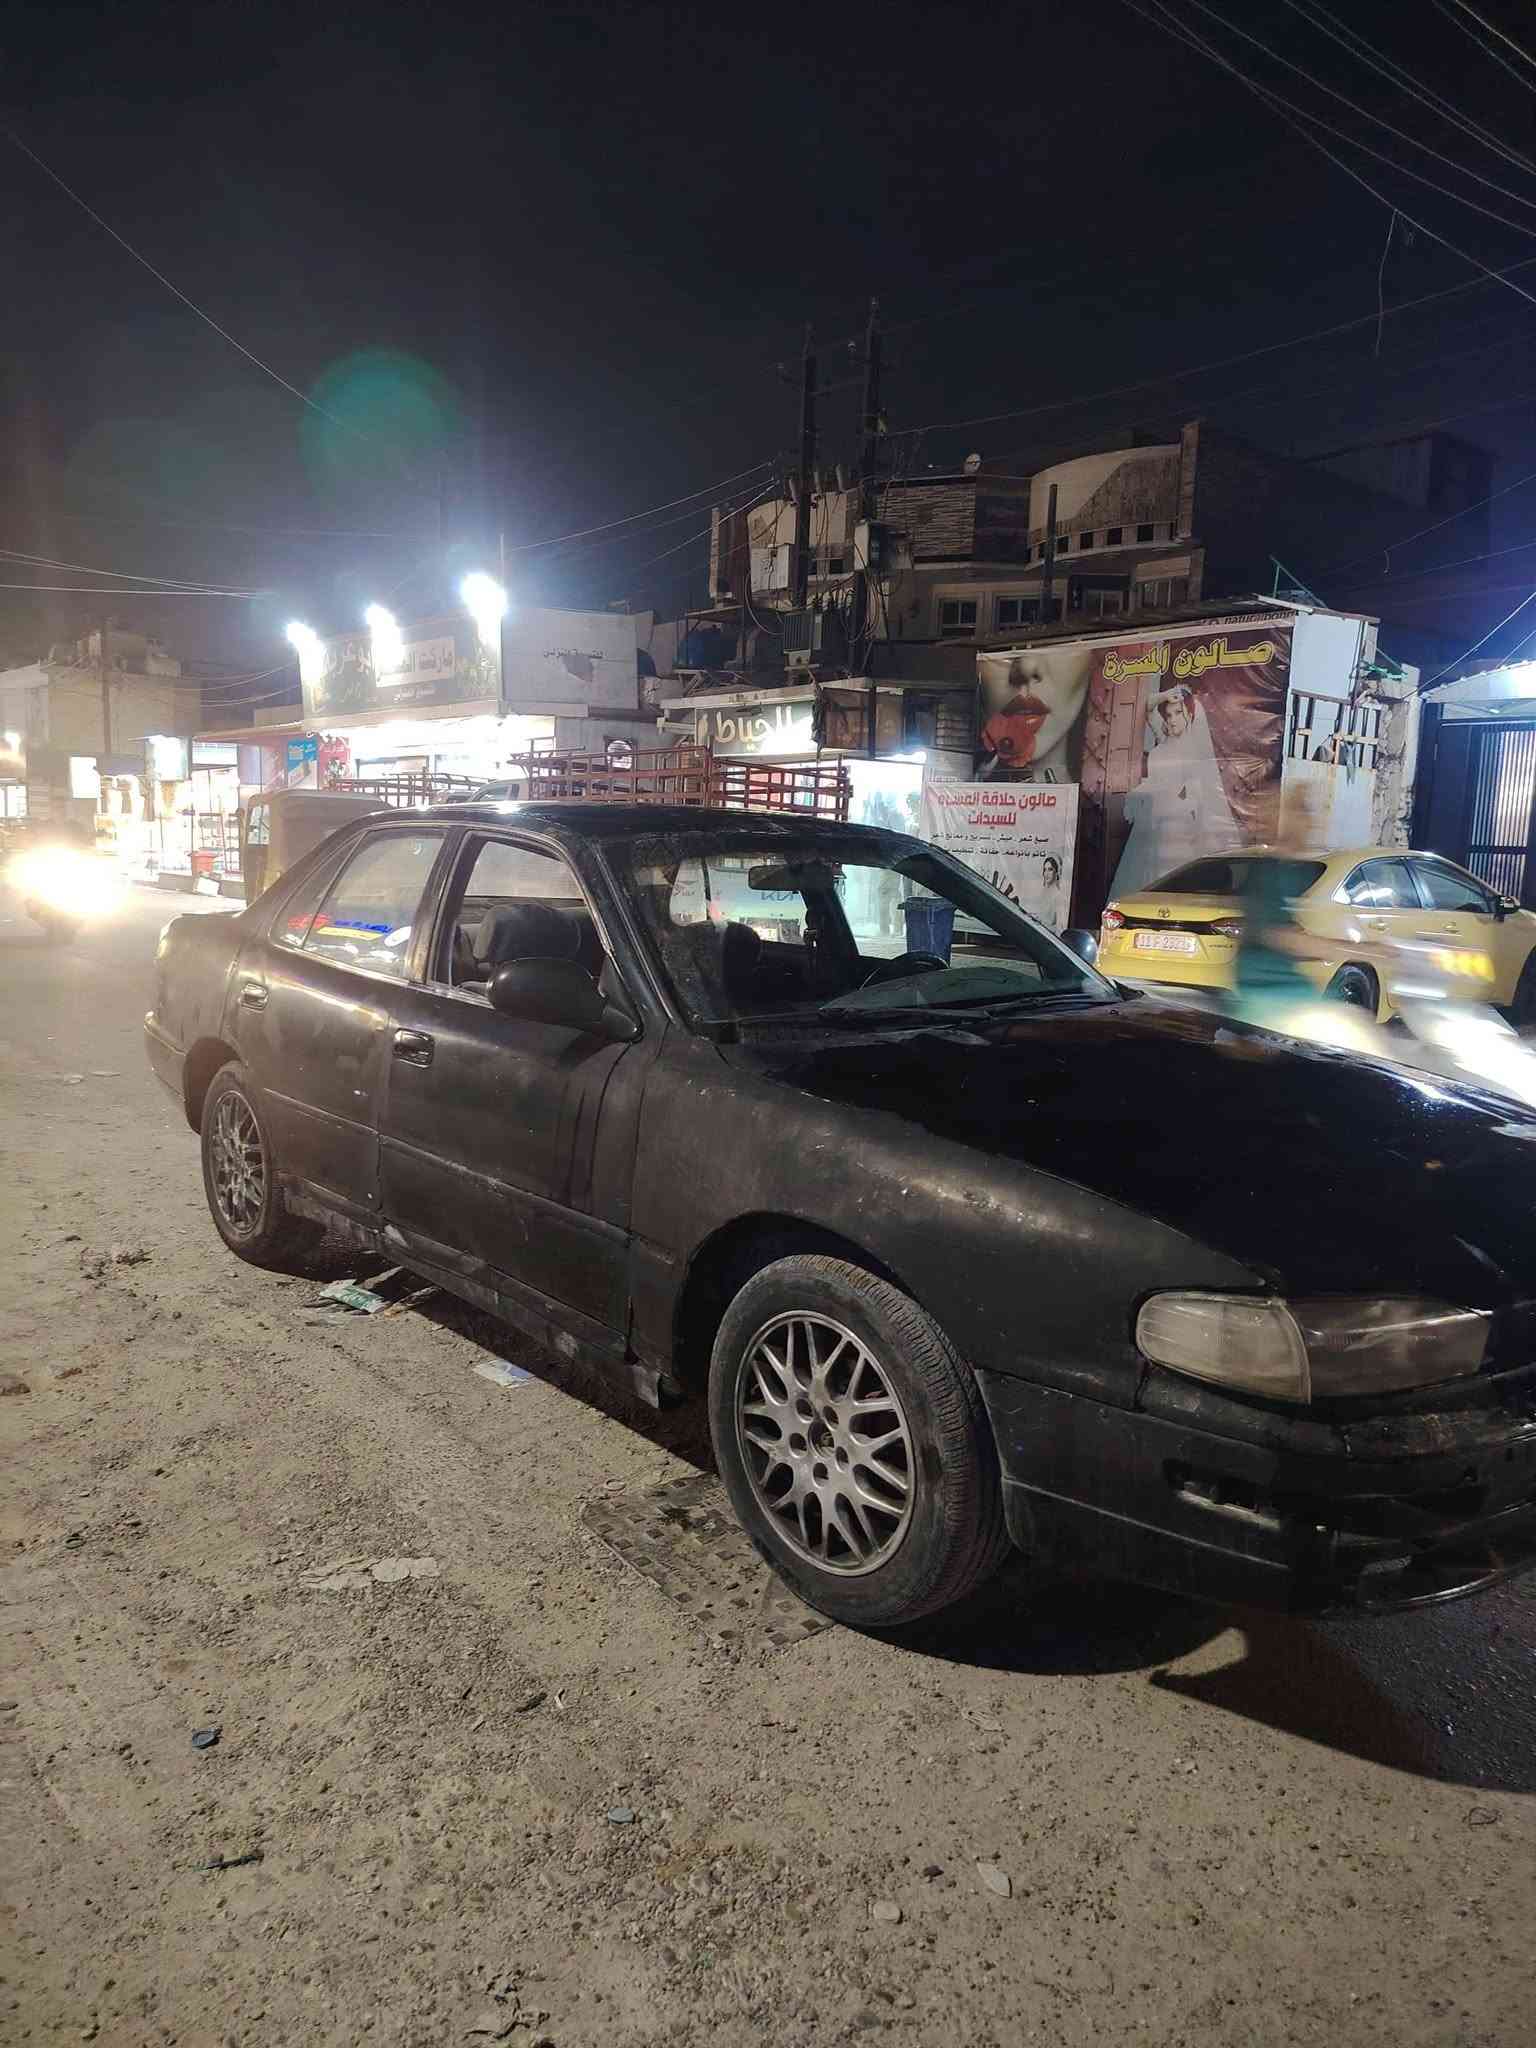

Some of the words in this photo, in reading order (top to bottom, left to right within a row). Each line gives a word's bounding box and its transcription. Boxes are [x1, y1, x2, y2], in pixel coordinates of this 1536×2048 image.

[1103, 643, 1170, 684] المسرة
[1172, 637, 1276, 679] صالون
[981, 790, 1016, 808] حلاقة
[1018, 792, 1057, 811] صالون
[967, 810, 1017, 829] للسيدات
